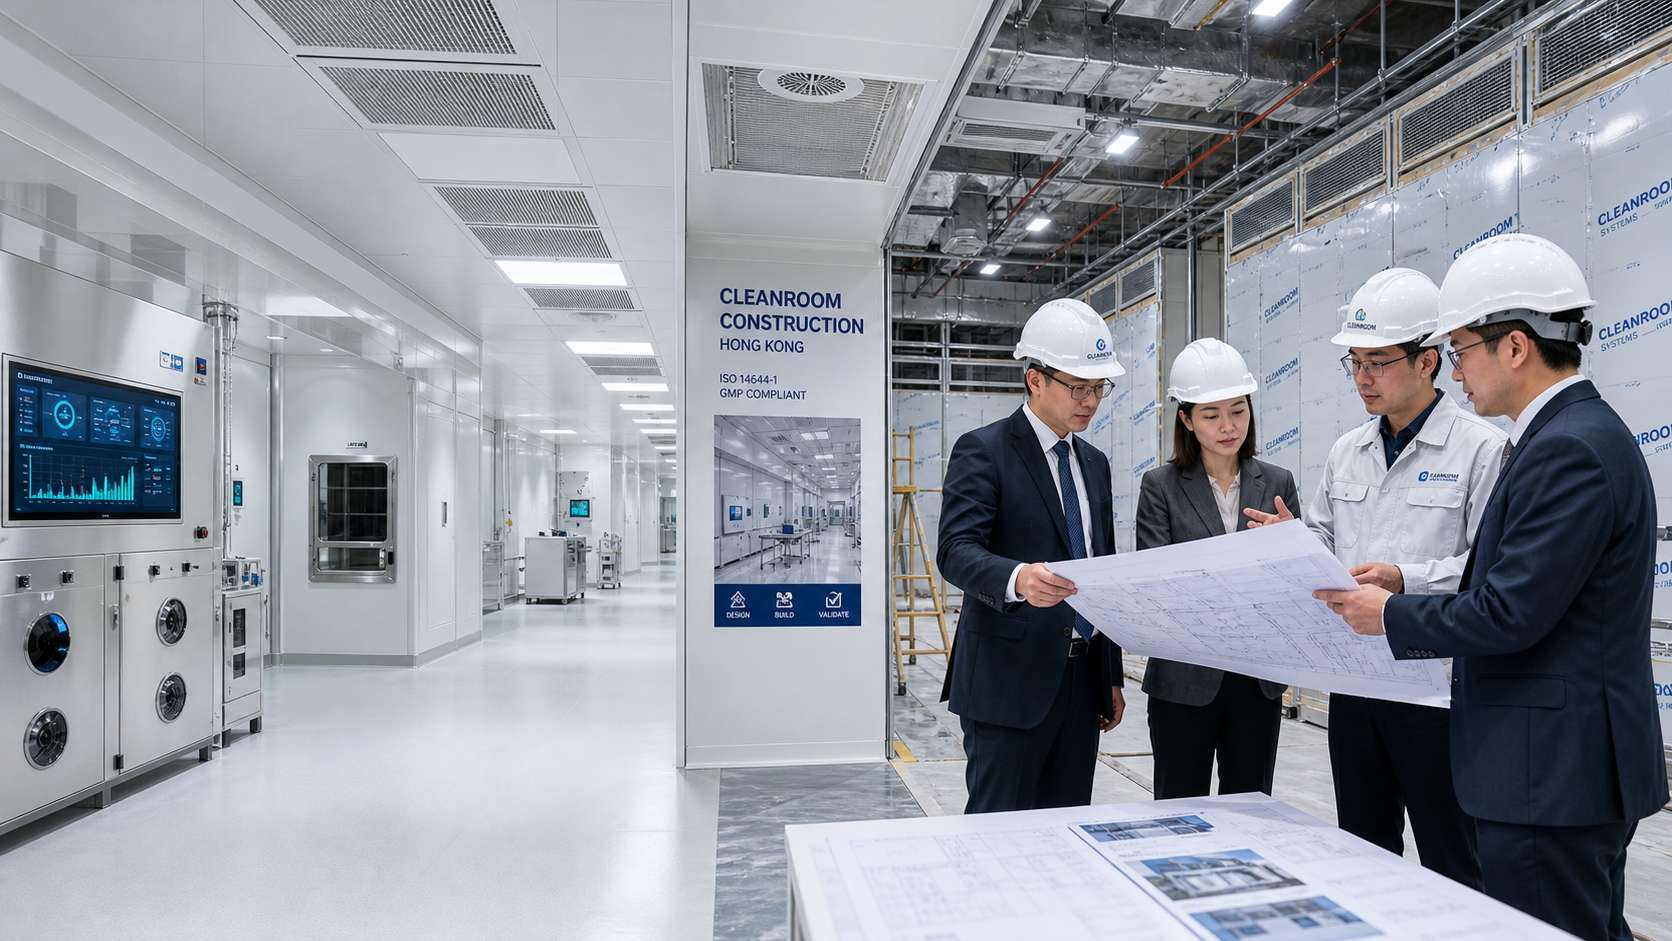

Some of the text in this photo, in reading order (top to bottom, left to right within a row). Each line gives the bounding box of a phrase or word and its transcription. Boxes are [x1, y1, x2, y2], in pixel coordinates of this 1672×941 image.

[1598, 177, 1672, 226] CLEANROO
[1600, 212, 1639, 237] SYSTEMS
[720, 287, 841, 309] CLEANROOM
[720, 312, 864, 334] CONSTRUCTION
[1598, 300, 1672, 341] CLEANROO
[720, 338, 805, 353] HONG KONG
[1601, 331, 1639, 352] SYSTEMS
[719, 374, 778, 384] ISO 14644-1
[719, 388, 807, 400] GMP COMPLIANT
[726, 611, 751, 619] DESIGN
[774, 611, 795, 619] BUILD
[818, 610, 850, 619] VALIDATE
